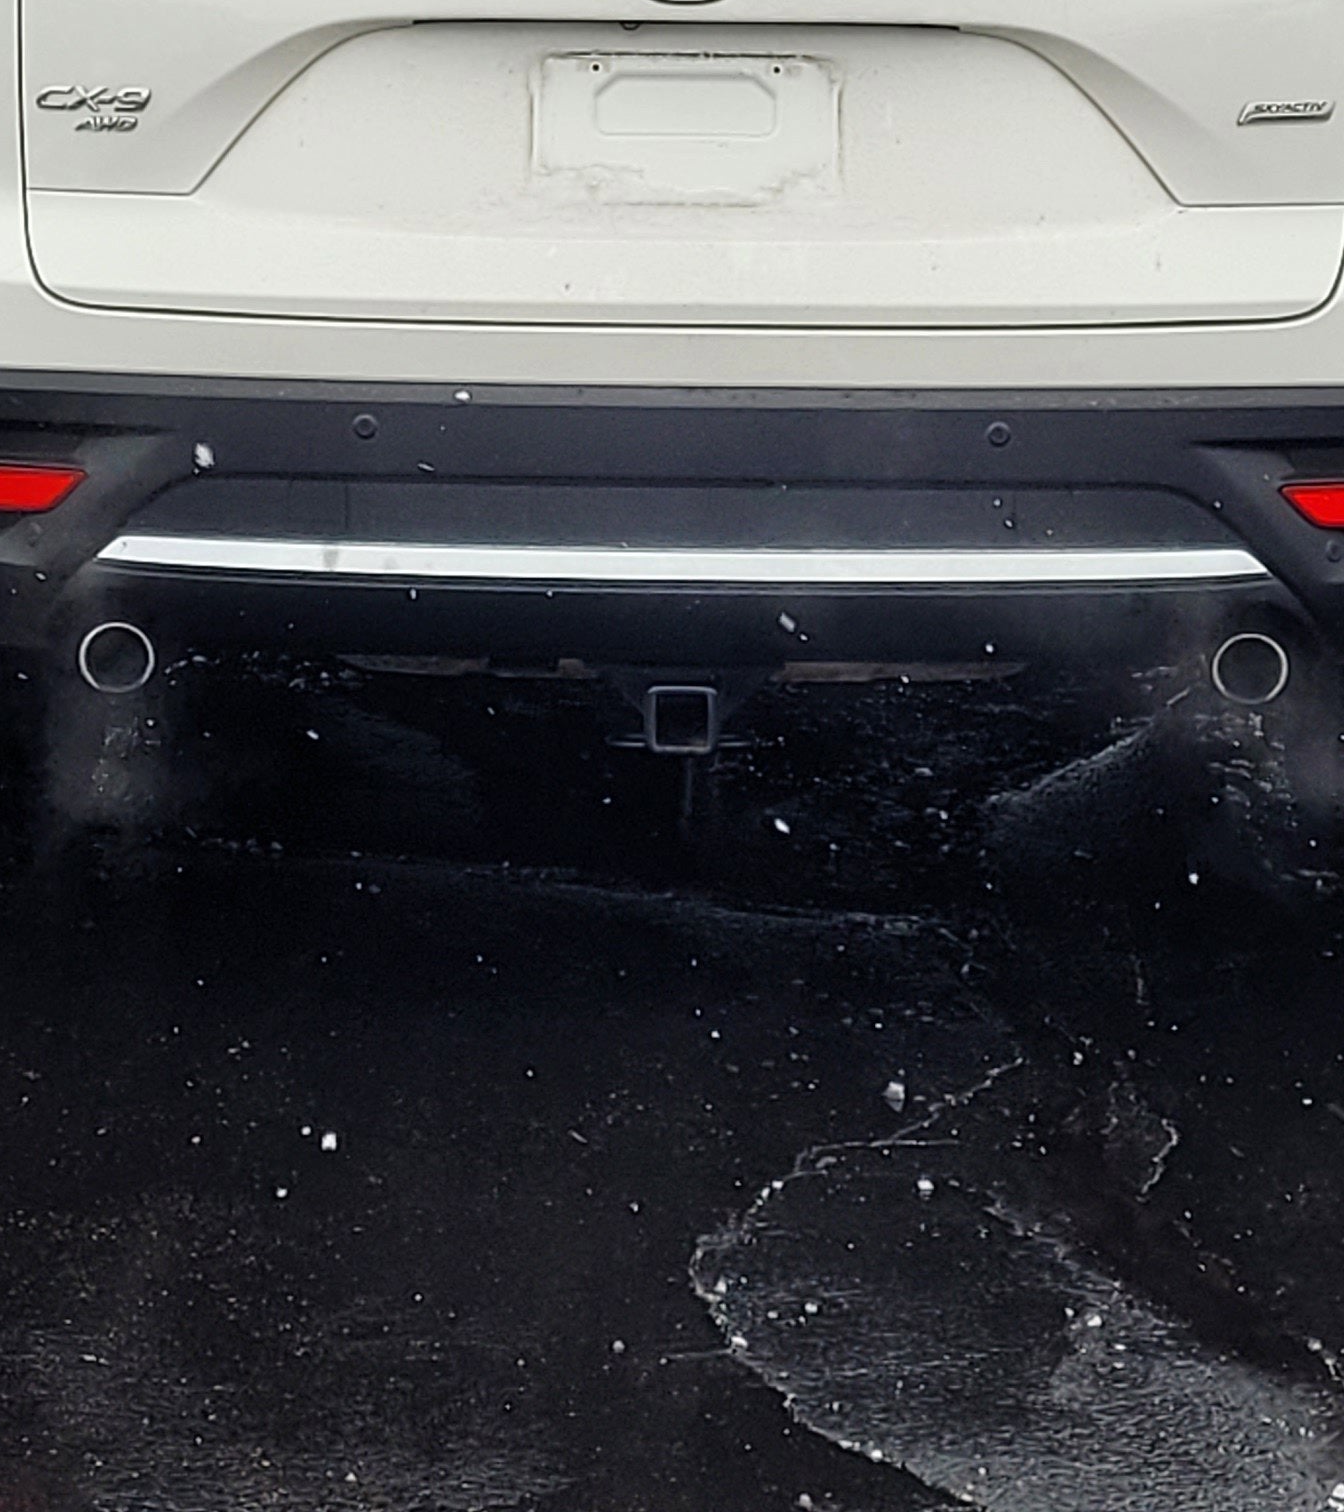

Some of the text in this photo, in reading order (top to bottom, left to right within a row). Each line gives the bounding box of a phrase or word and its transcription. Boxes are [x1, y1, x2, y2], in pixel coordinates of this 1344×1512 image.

[36, 85, 152, 112] CX-9
[1254, 101, 1328, 113] SKYACTIV
[75, 115, 138, 132] AWD
